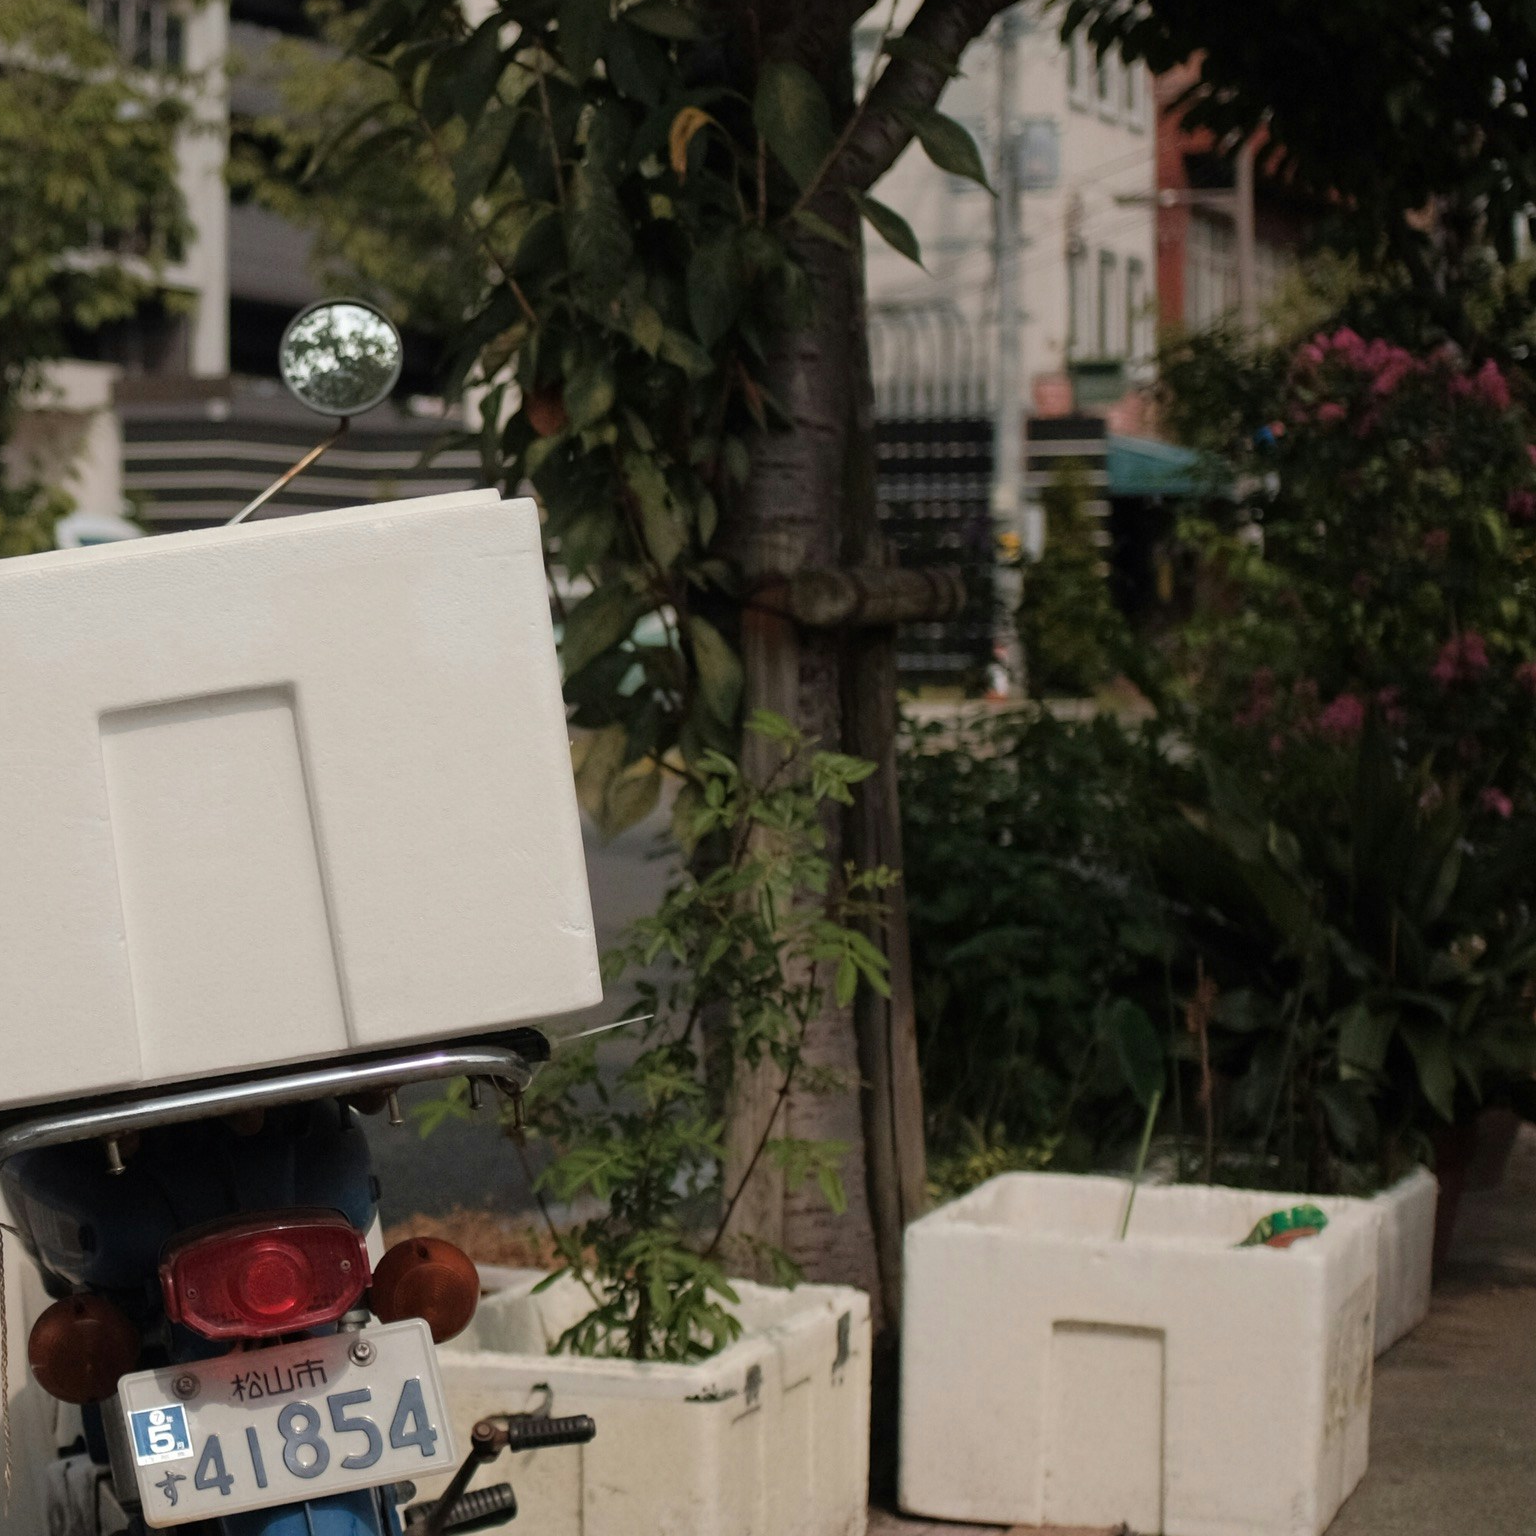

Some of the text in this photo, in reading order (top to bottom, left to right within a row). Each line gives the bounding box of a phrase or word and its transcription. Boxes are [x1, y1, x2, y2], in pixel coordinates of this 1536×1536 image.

[232, 1358, 328, 1402] 松山市
[155, 1376, 439, 1507] す 41854
